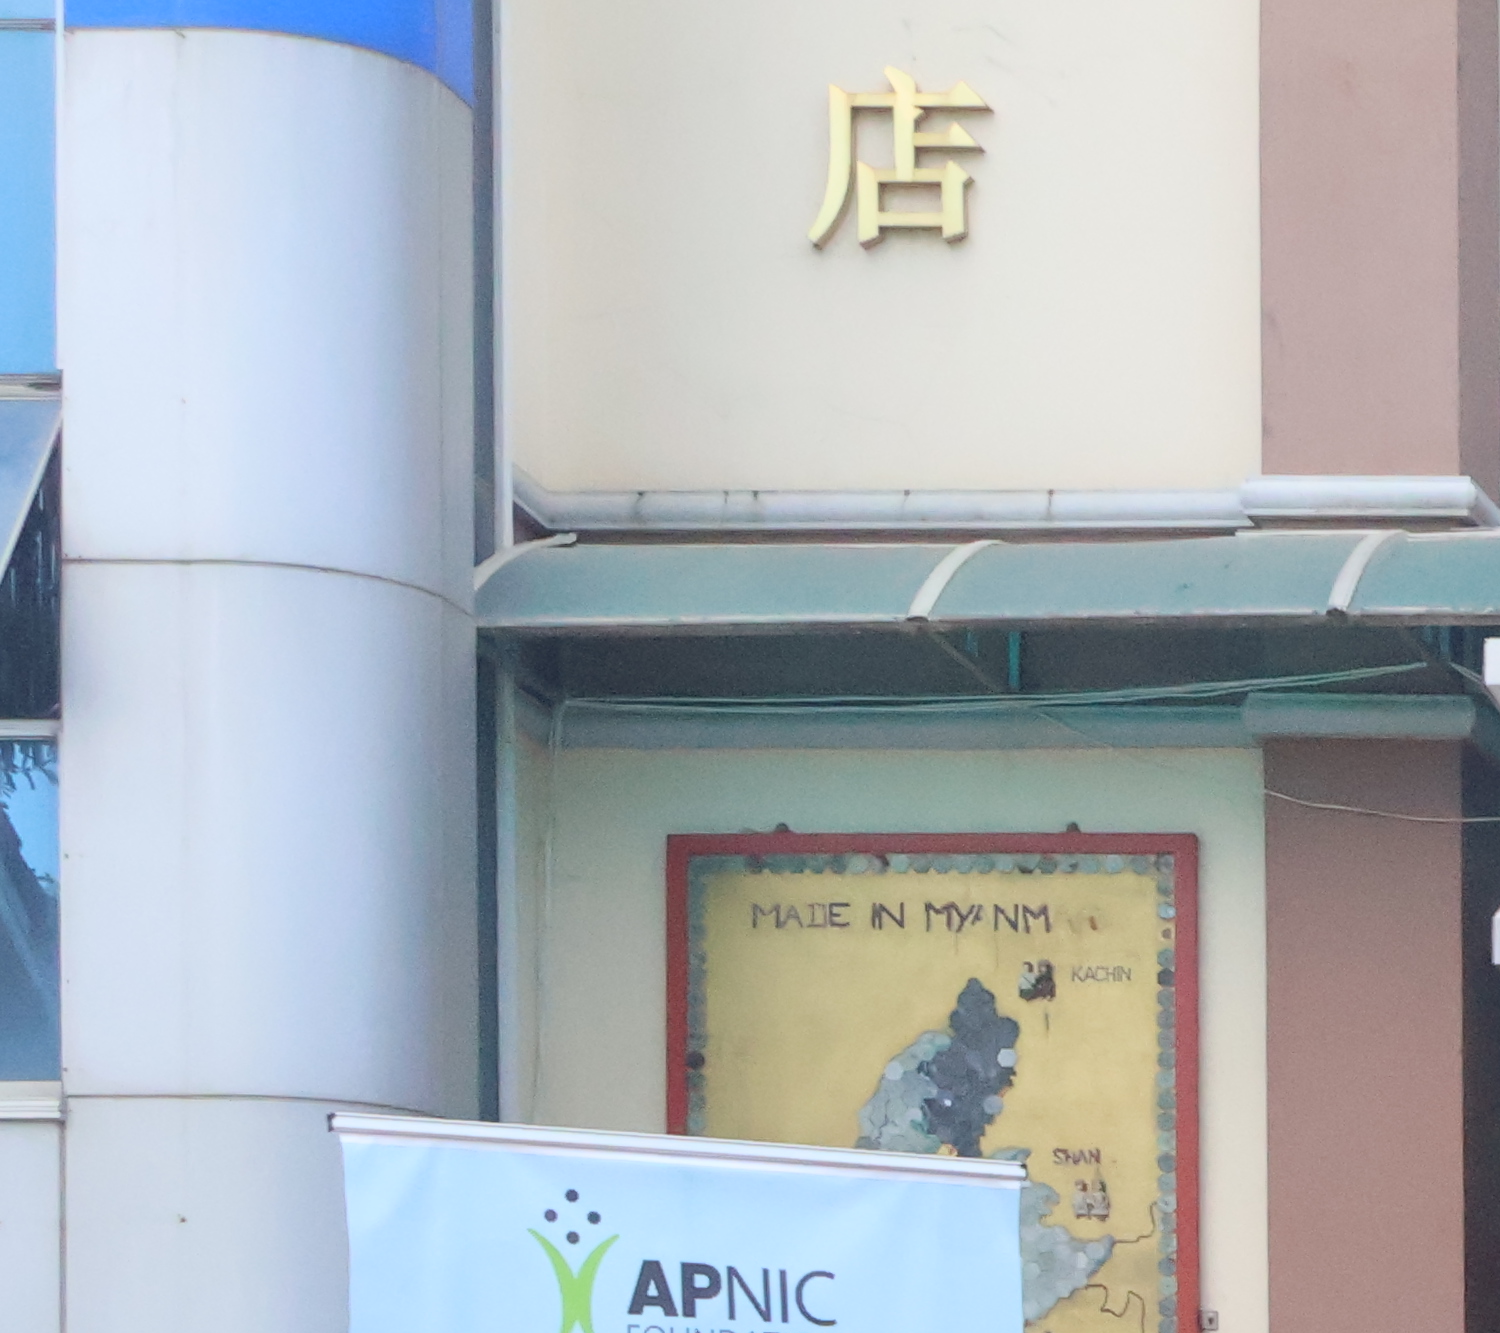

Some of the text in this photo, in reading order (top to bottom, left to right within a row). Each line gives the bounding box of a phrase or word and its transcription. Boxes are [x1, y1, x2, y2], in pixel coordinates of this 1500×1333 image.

[806, 64, 995, 251] 店
[752, 901, 850, 928] MADE
[872, 902, 905, 930] IN
[1071, 964, 1132, 983] KACHIN
[627, 1259, 838, 1327] APNIC
